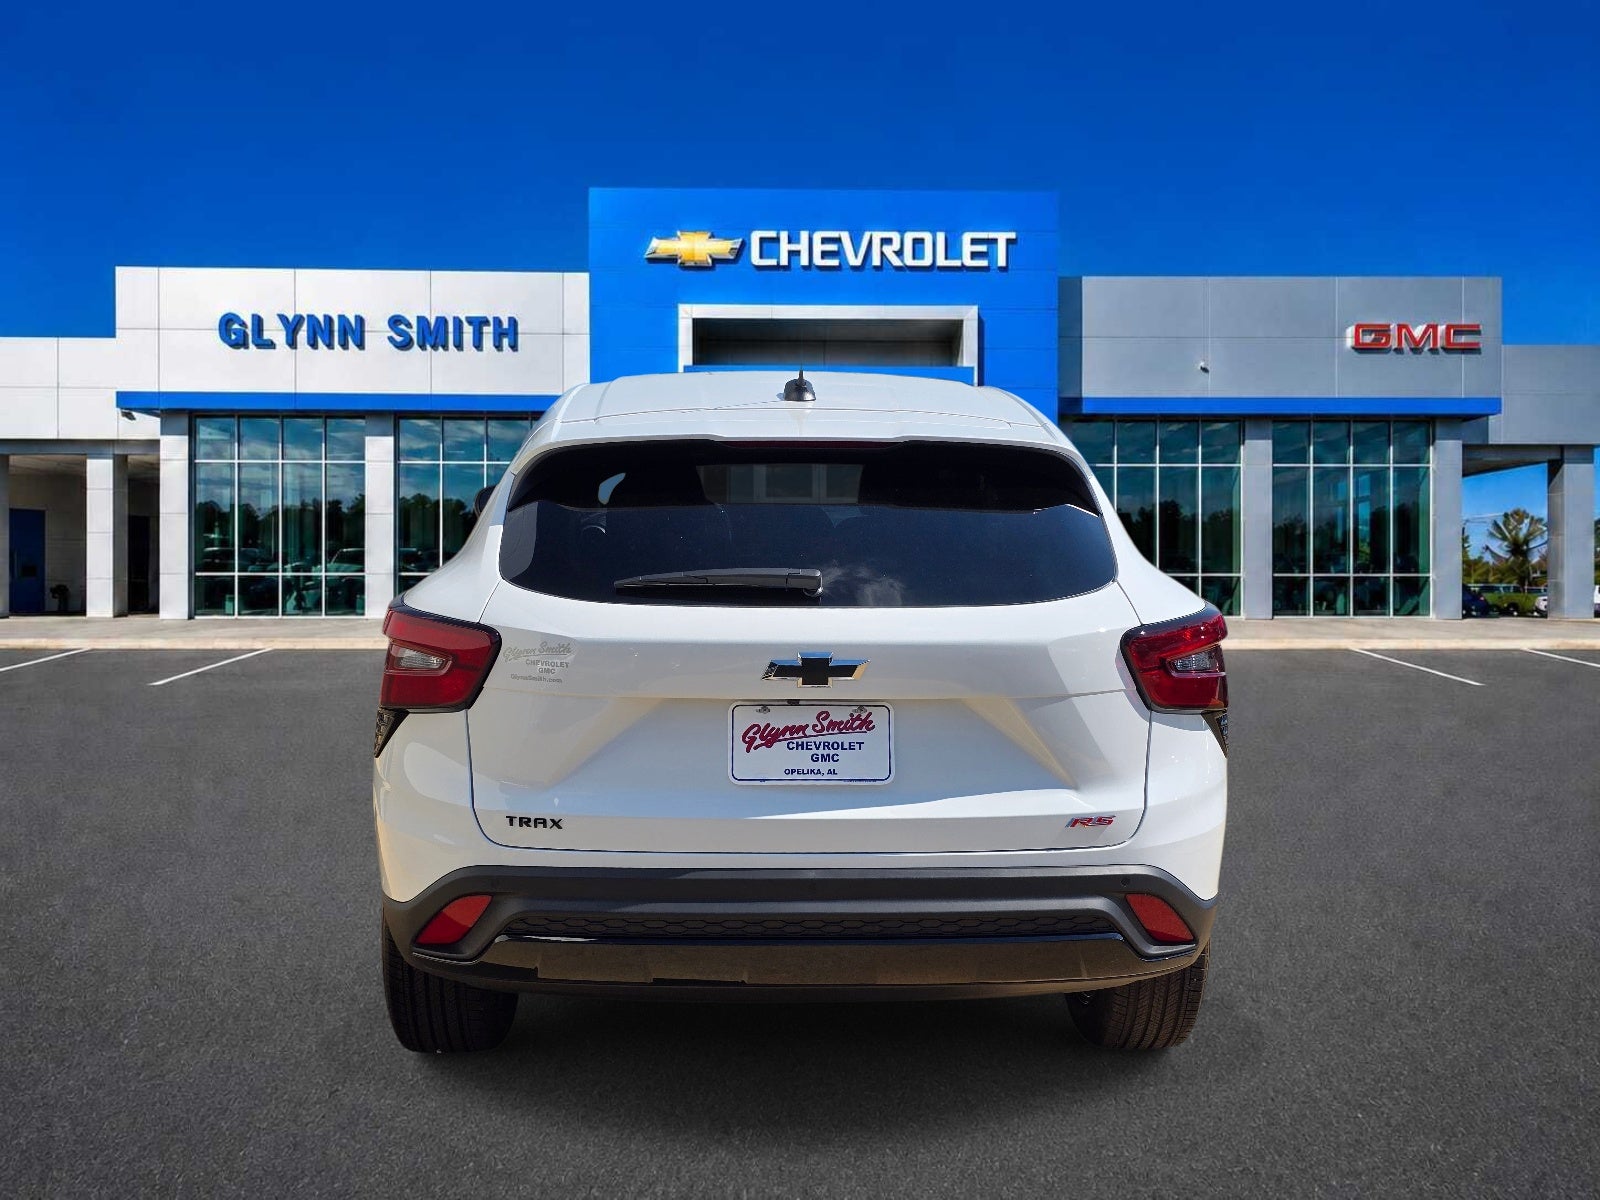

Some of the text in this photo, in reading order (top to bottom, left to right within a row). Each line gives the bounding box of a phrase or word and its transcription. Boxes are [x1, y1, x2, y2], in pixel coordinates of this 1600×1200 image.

[751, 230, 1017, 268] CHEVROLET
[218, 312, 519, 352] GLYNN SMITH
[1350, 322, 1482, 352] GMC
[538, 641, 572, 654] Smith
[525, 659, 570, 668] CHEVROLET
[538, 667, 556, 675] GMC
[741, 710, 876, 753] Glynn Smith
[786, 741, 865, 751] CHEVROLET
[810, 753, 840, 763] GMC
[783, 768, 825, 776] OPELIKA,
[505, 815, 563, 829] TRAX
[1065, 815, 1116, 828] RS
